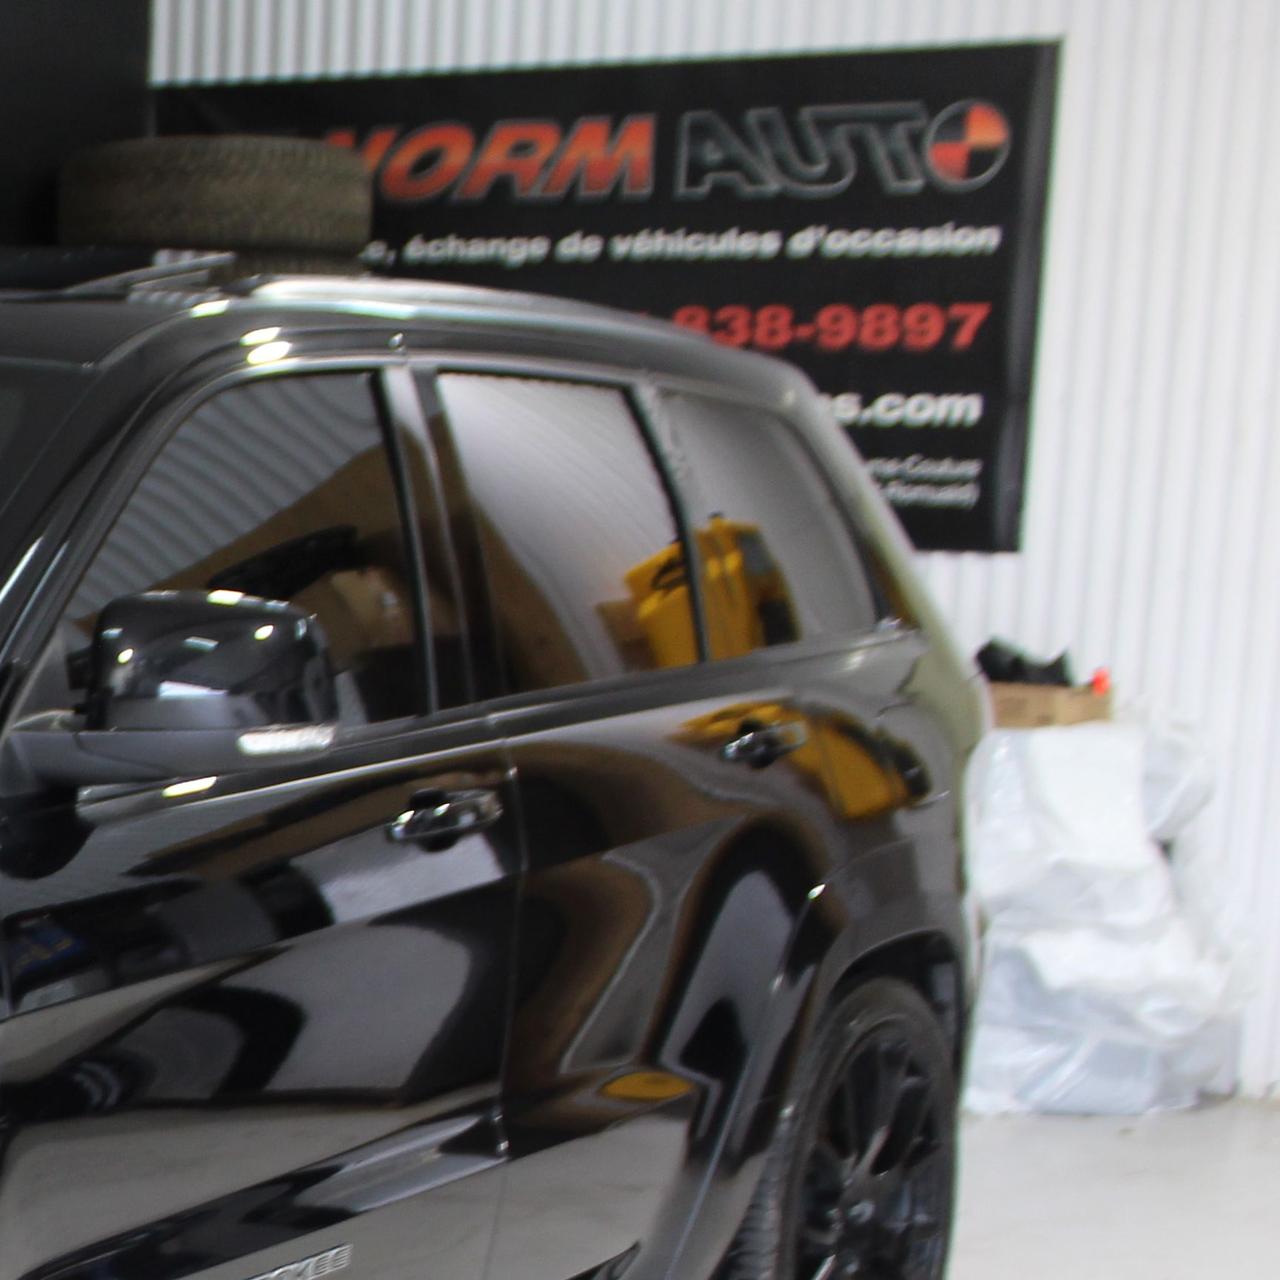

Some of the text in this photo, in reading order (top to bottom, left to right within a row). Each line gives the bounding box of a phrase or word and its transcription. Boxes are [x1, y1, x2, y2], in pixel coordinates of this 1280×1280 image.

[555, 230, 604, 263] de
[606, 226, 783, 262] véhicules
[786, 221, 1003, 260] d'occasion
